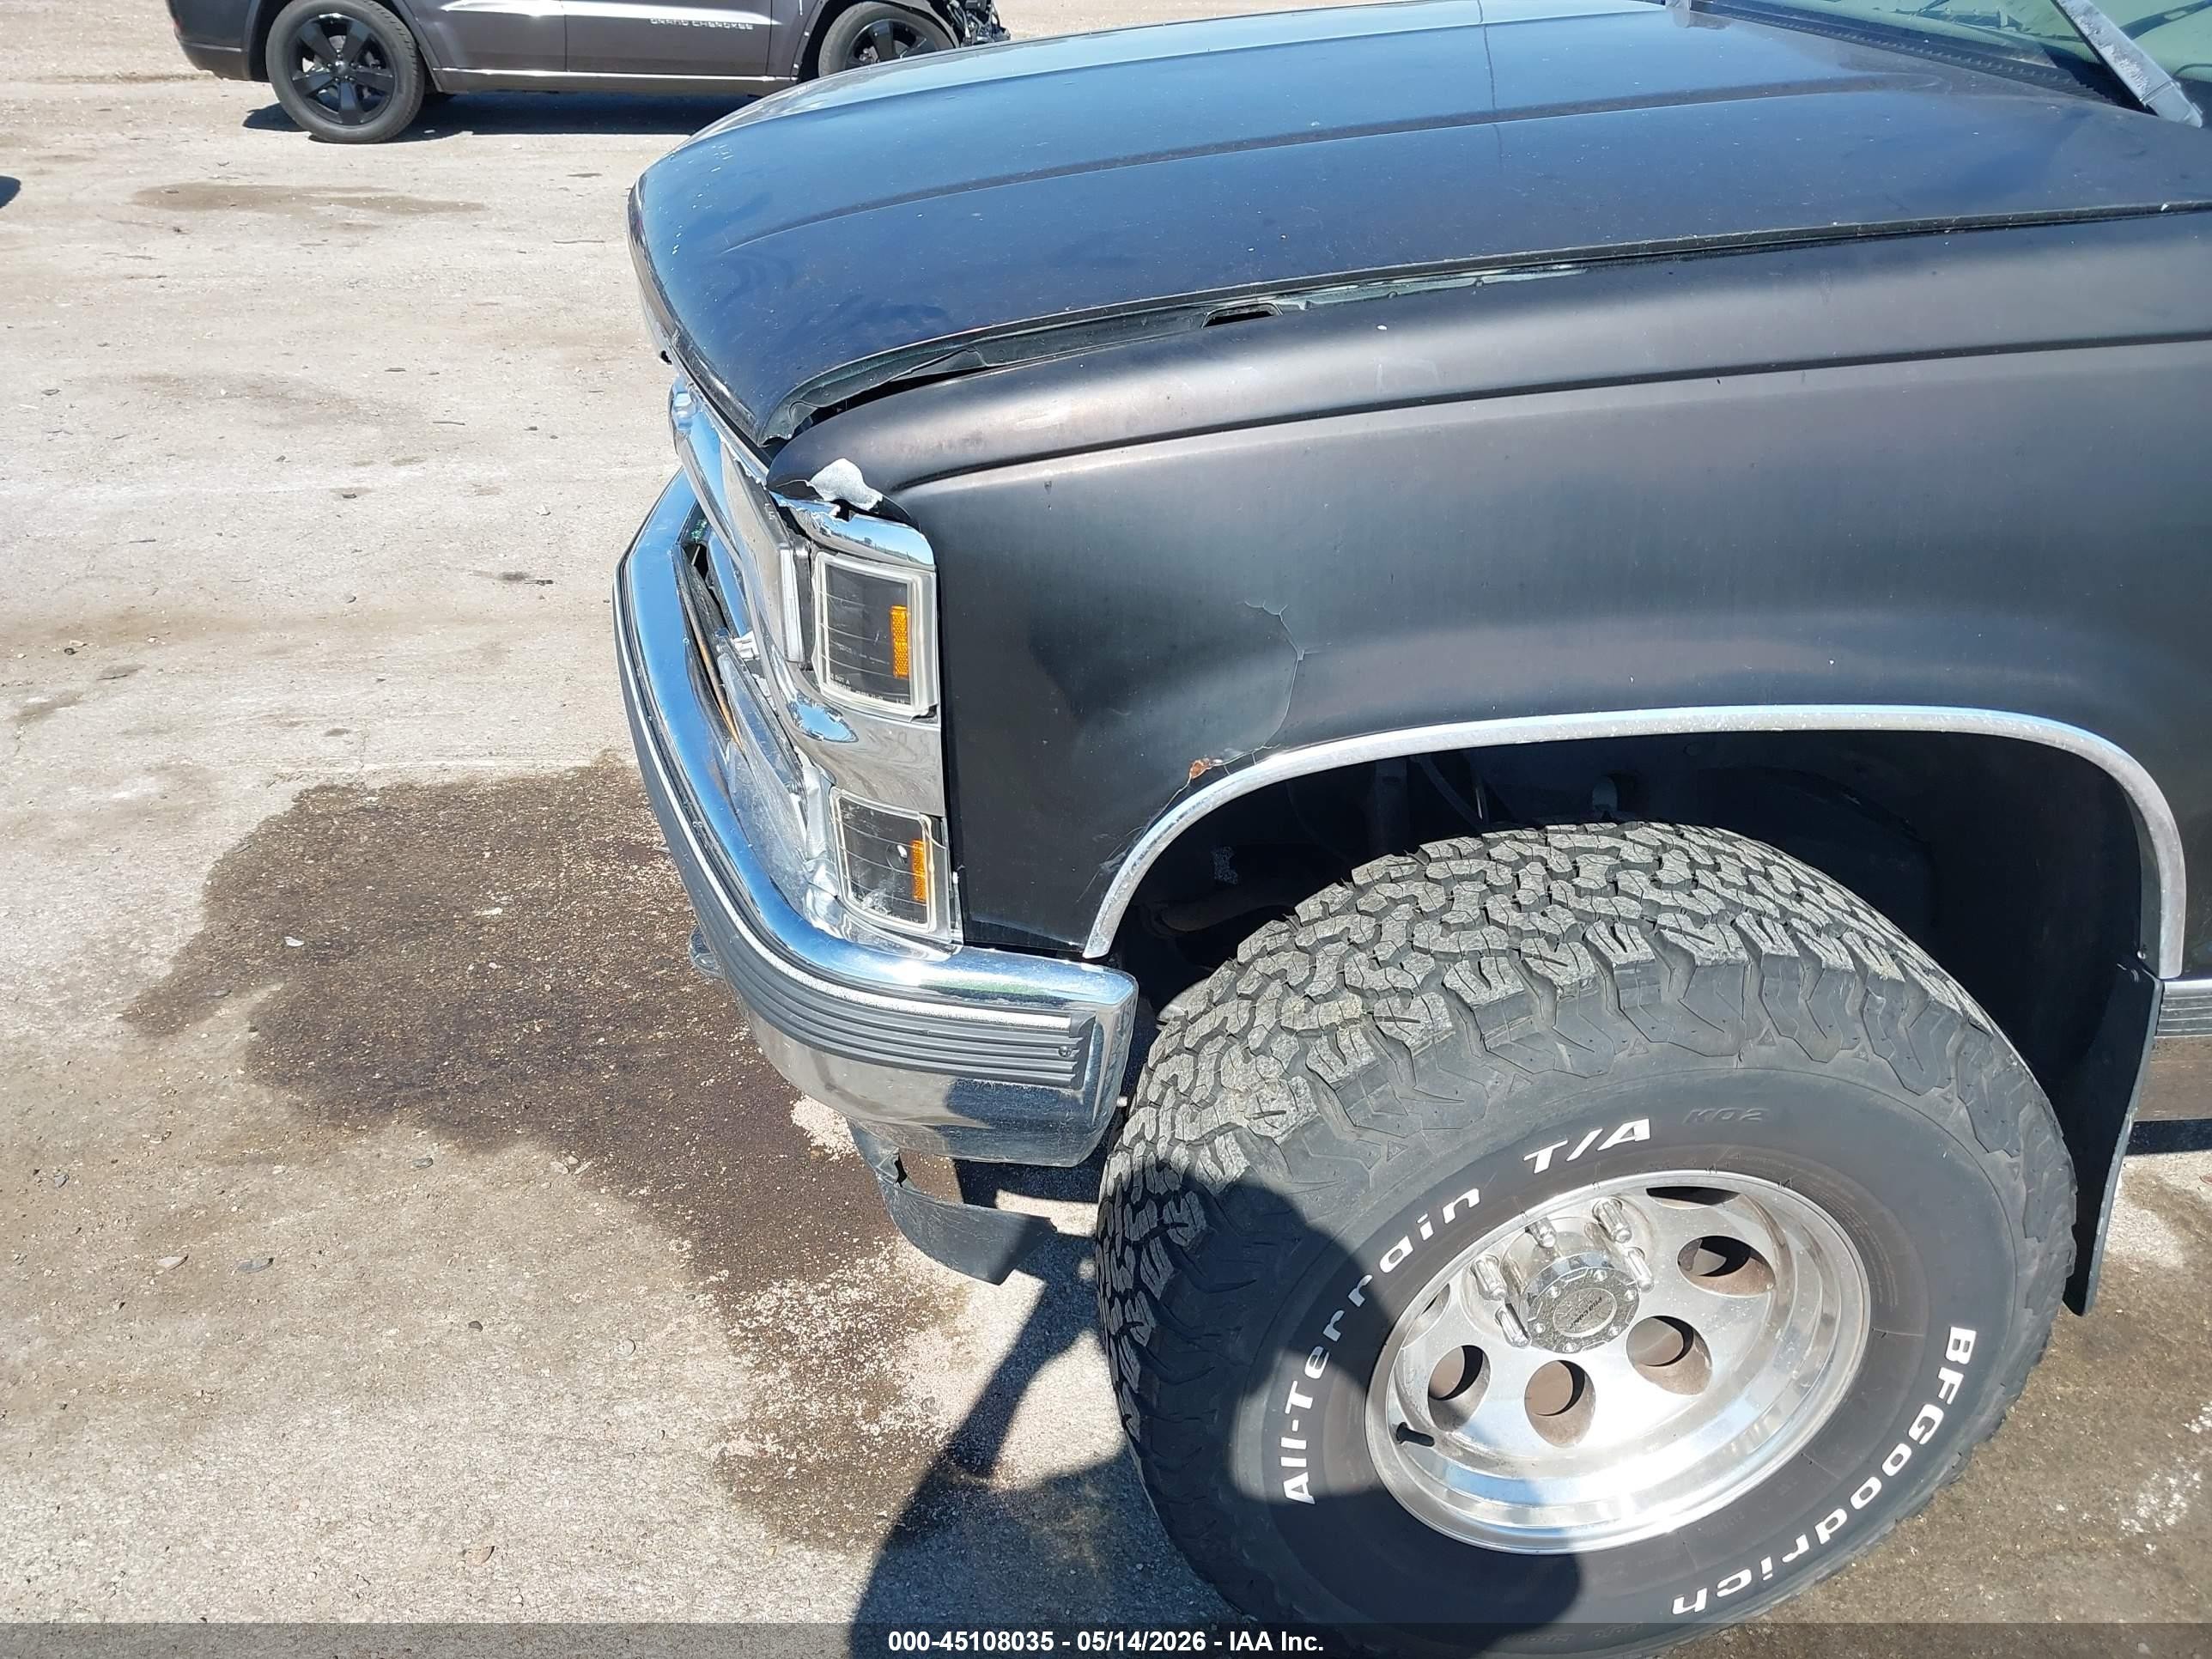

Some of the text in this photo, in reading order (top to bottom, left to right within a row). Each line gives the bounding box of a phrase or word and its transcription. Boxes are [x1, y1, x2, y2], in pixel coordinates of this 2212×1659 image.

[1280, 1188, 1480, 1504] All-Terrain
[1523, 1119, 1650, 1175] T/A
[1672, 1326, 1976, 1614] BFGoodrich
